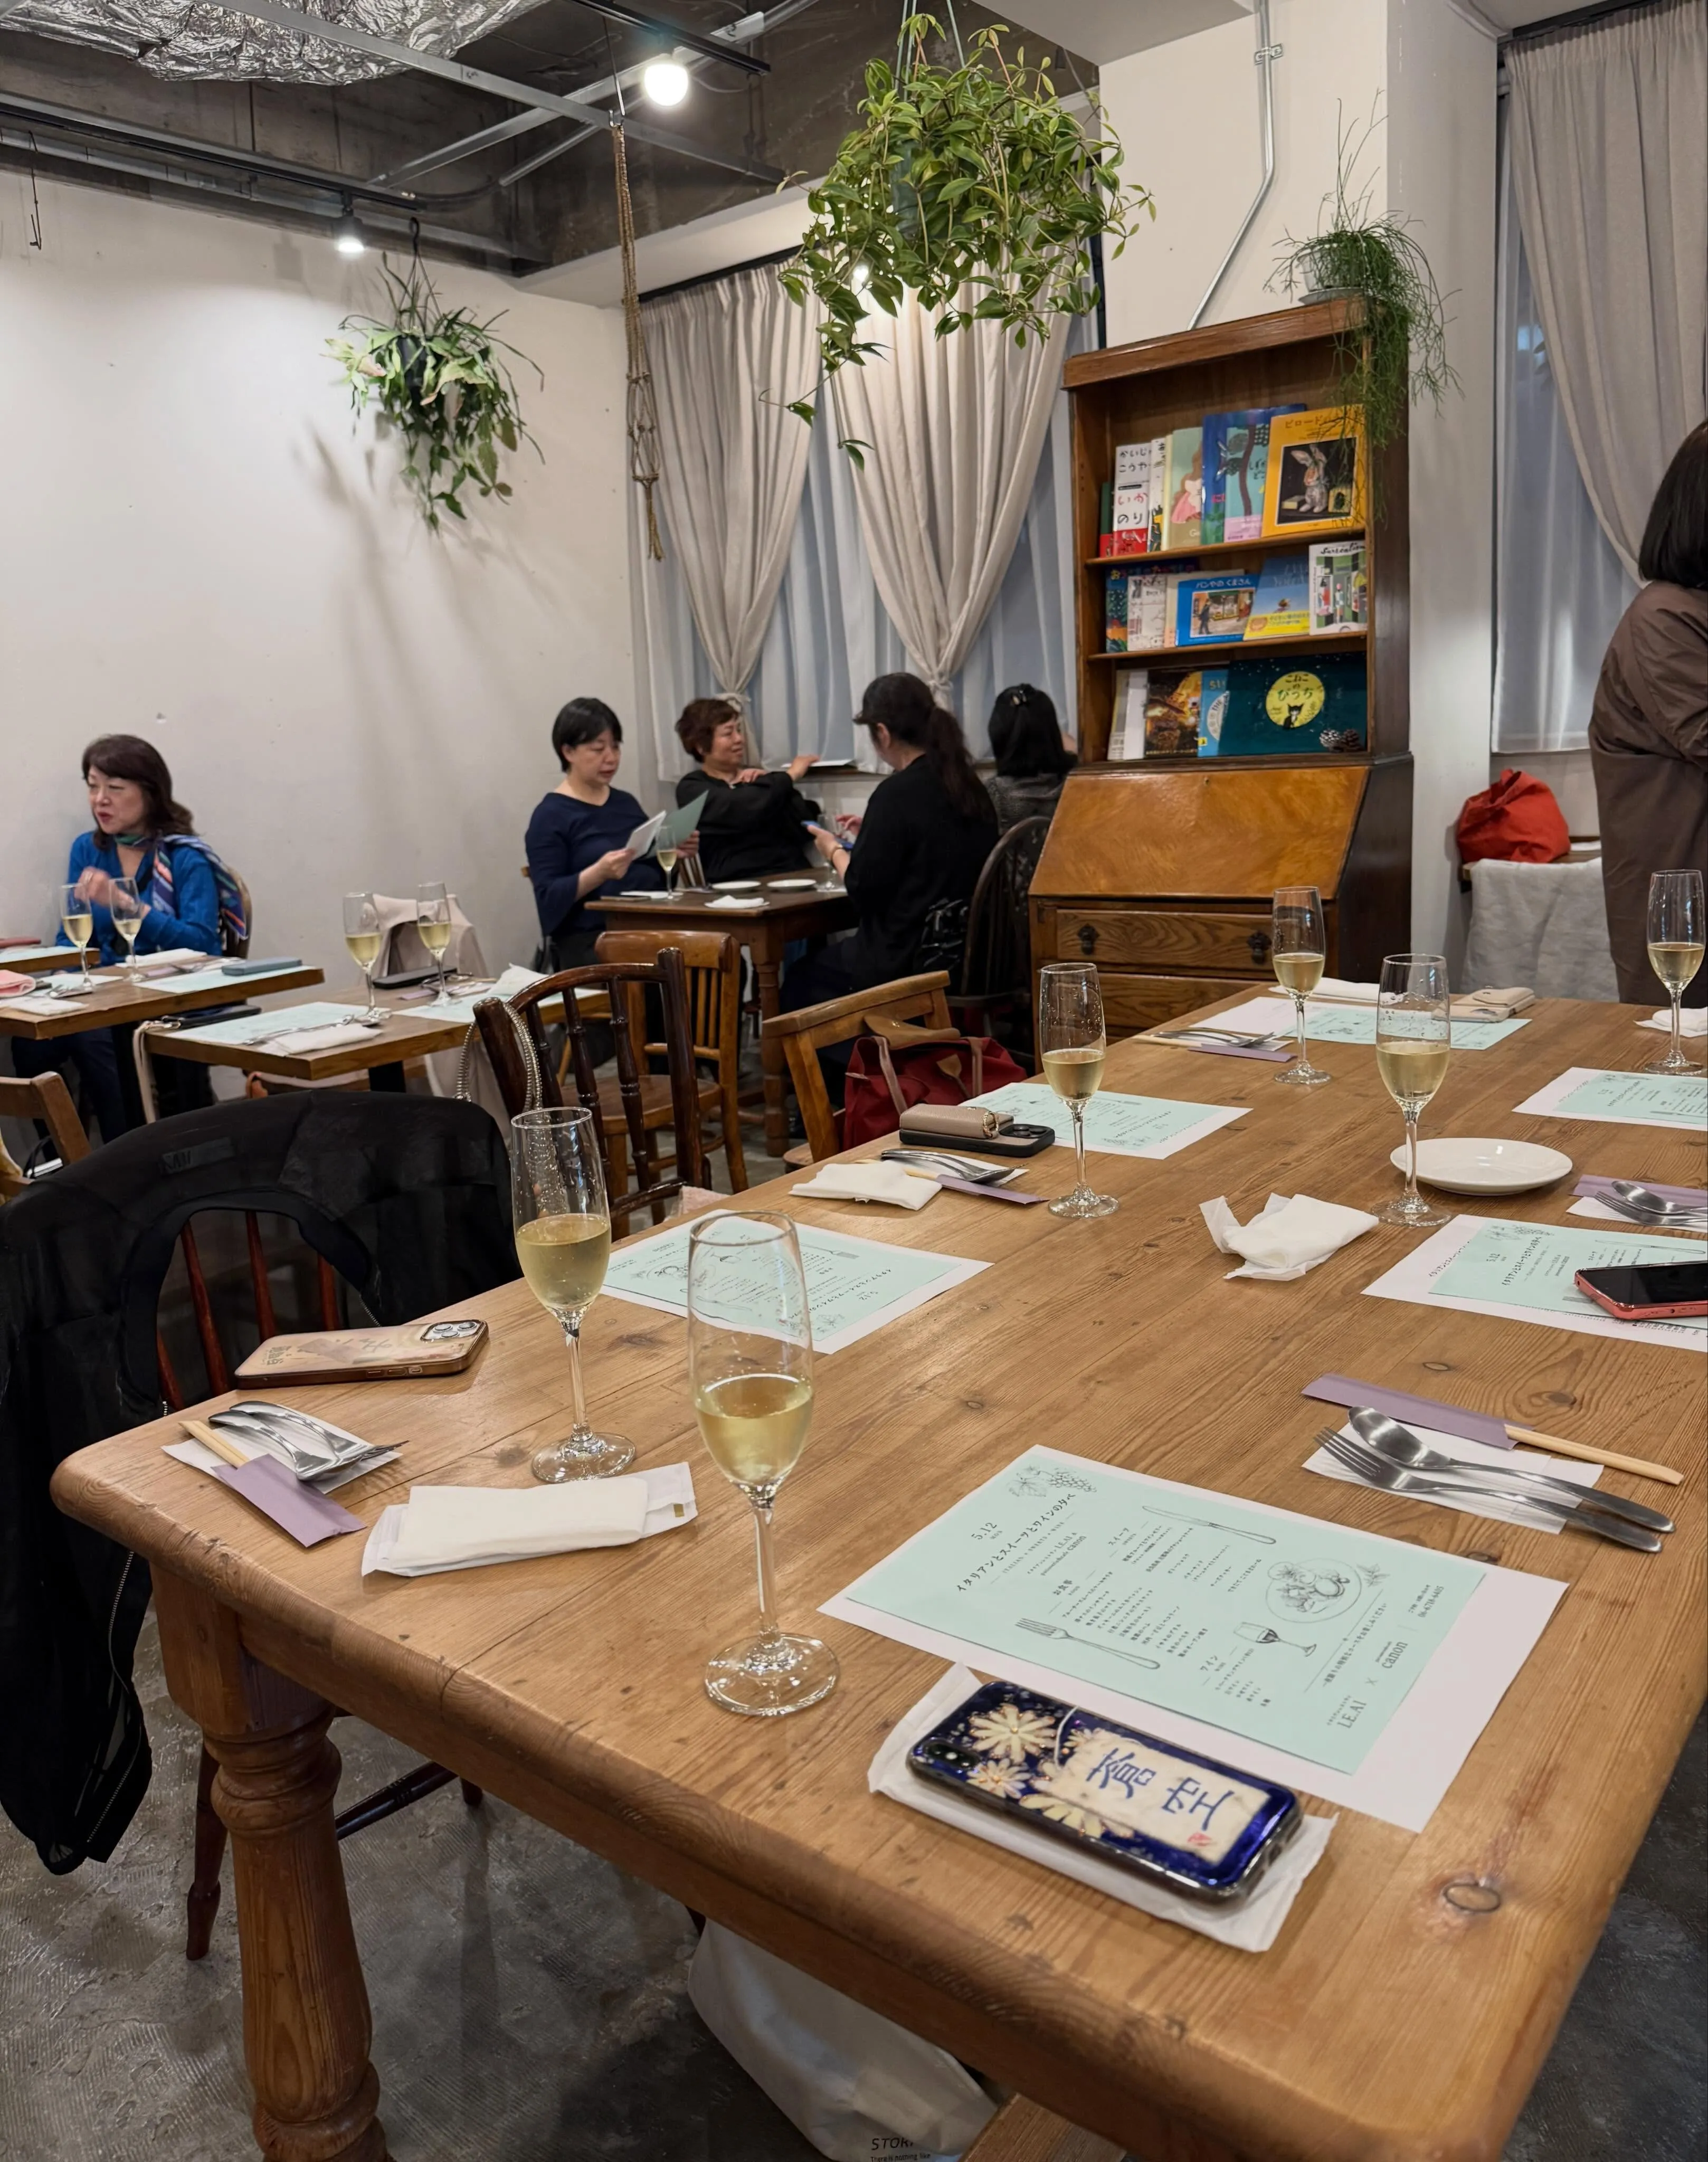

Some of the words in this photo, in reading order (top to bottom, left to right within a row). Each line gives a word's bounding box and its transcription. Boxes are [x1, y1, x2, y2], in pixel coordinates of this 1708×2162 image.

[971, 1522, 997, 1540] 5.12
[1108, 1527, 1130, 1546] スイーツ
[1067, 1535, 1087, 1551] canon
[1052, 1579, 1073, 1596] お食事
[1199, 1655, 1218, 1672] ワイン
[1381, 1642, 1408, 1669] canon
